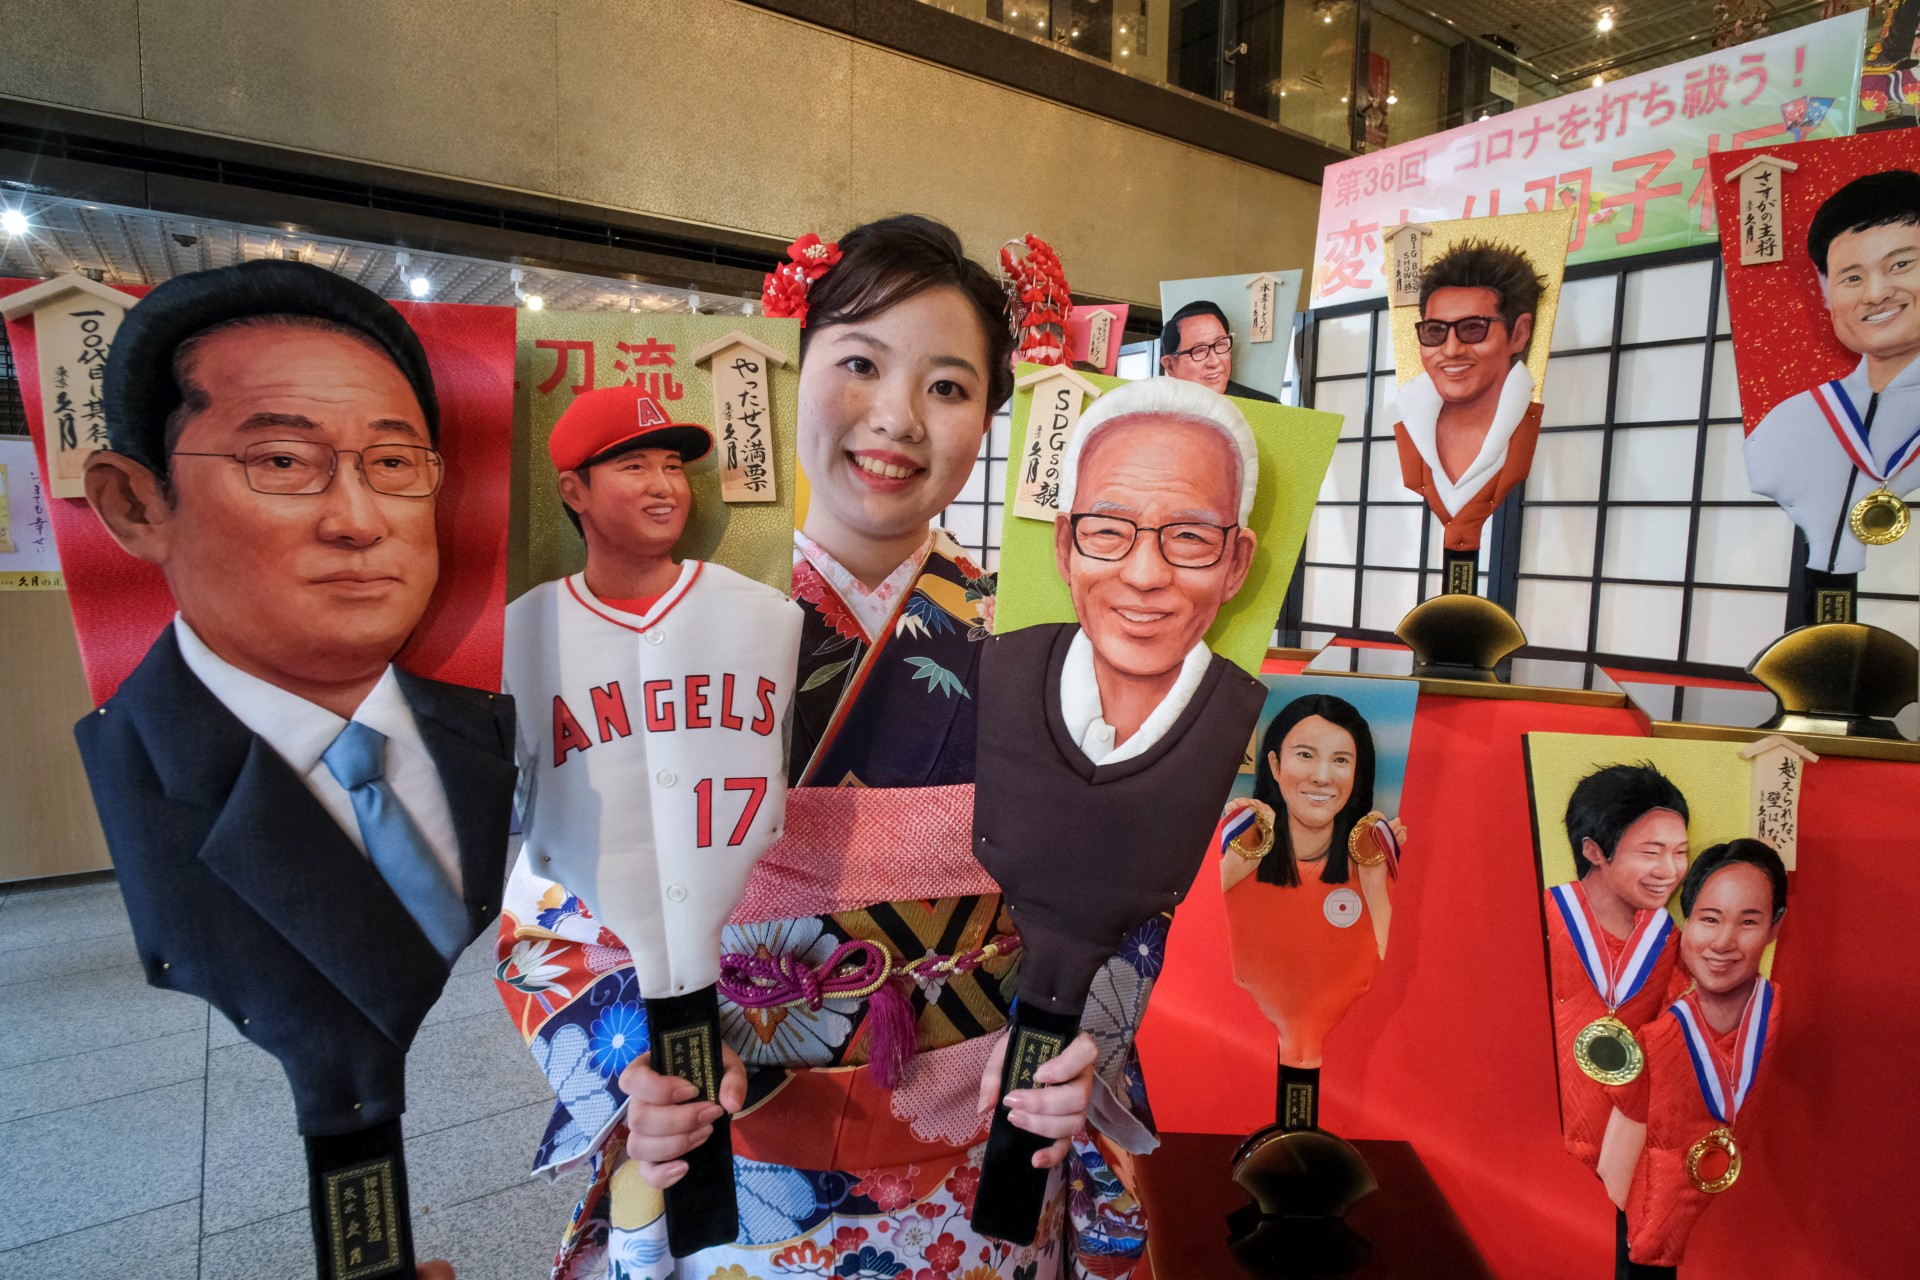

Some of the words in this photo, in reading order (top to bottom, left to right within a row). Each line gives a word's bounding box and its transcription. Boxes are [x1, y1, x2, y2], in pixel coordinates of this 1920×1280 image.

[1334, 150, 1428, 208] 第36回
[1754, 170, 1778, 257] さすがの主将
[514, 337, 684, 400] 刀流
[53, 391, 78, 452] 久月
[637, 397, 665, 427] A
[723, 423, 739, 470] 久月
[1026, 441, 1042, 484] 久月
[1031, 389, 1071, 509] SDGsの親
[552, 672, 776, 768] ANGELS
[693, 777, 768, 849] 17
[1779, 757, 1797, 843] 越えられない
